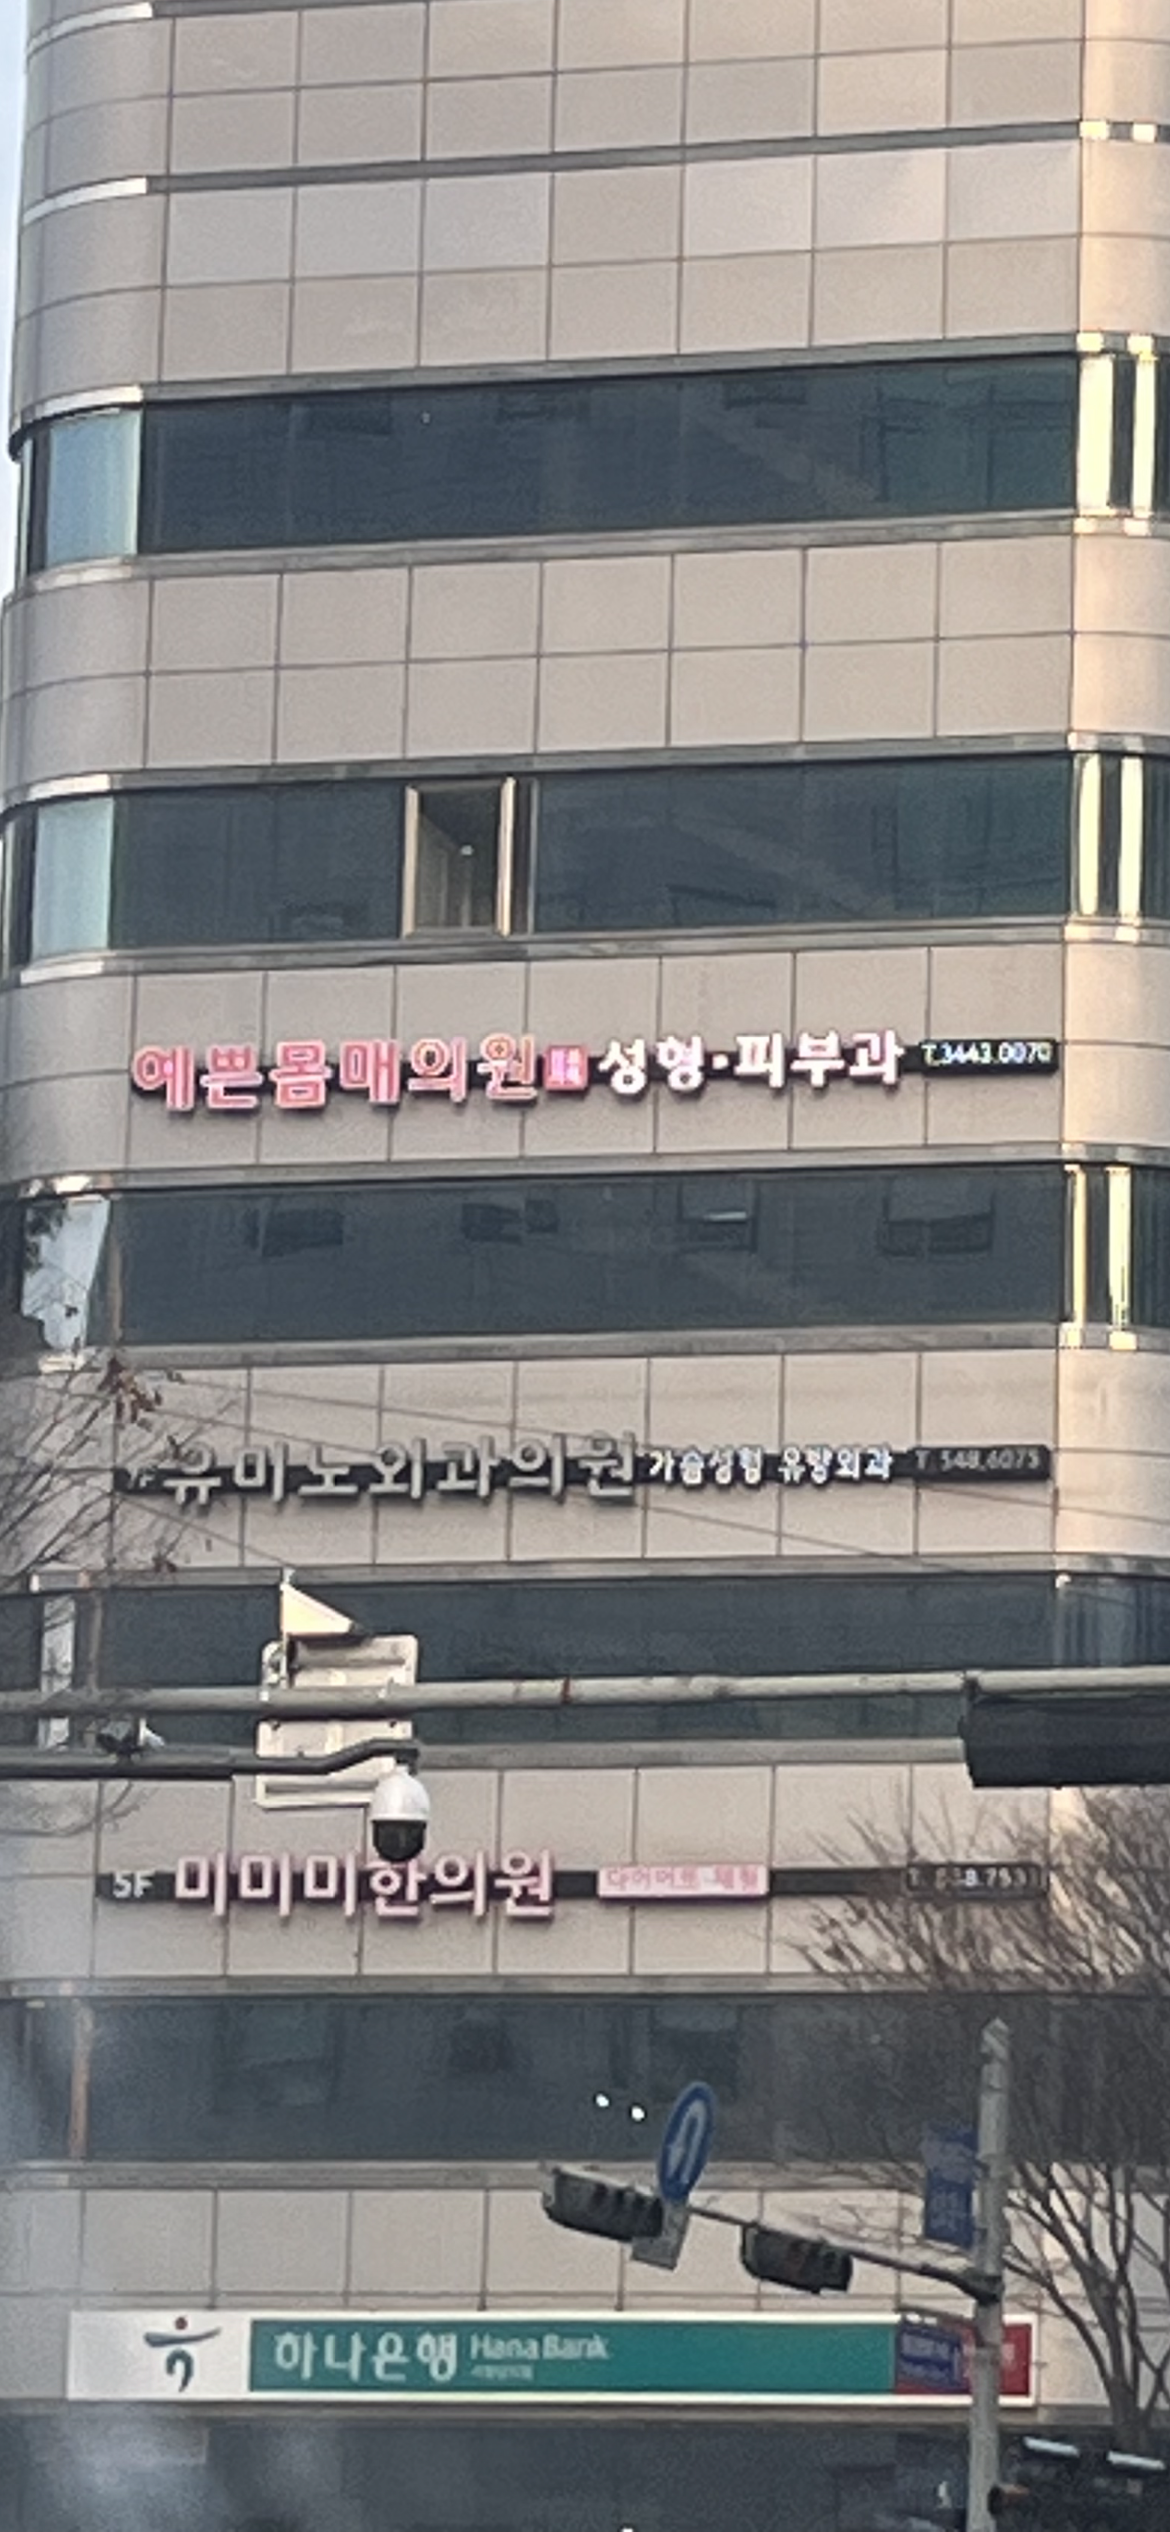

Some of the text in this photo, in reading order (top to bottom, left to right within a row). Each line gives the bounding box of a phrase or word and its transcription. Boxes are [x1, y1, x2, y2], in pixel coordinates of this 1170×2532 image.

[132, 1033, 537, 1111] 예쁜몸매의원
[163, 1430, 636, 1503] 유미노외과의원
[112, 1870, 154, 1898] 5F
[175, 1850, 553, 1917] 미미미한의원
[274, 2330, 458, 2383] 하나은행
